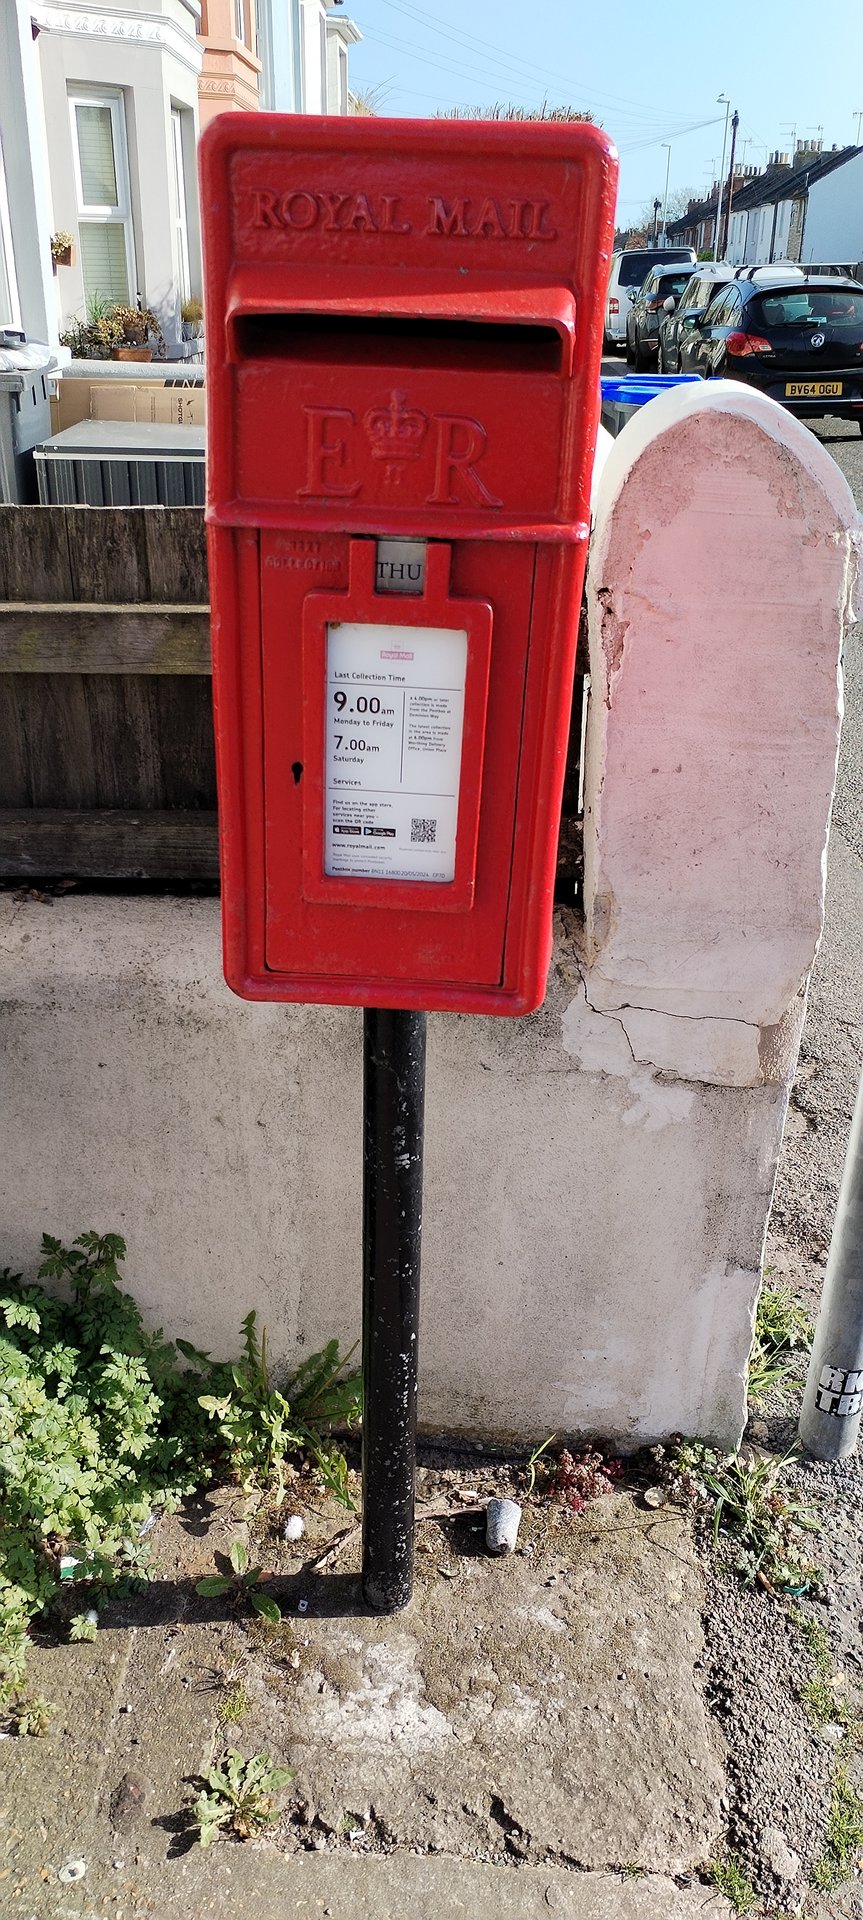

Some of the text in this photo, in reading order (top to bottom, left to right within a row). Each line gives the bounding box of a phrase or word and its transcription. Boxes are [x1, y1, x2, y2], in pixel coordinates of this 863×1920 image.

[251, 188, 558, 241] ROYAL MAIL
[790, 384, 839, 395] BV64 OGU
[297, 404, 503, 508] E R
[376, 562, 423, 581] THU
[334, 671, 406, 682] Last Collection Time
[334, 718, 360, 727] Monday
[372, 720, 394, 729] Friday
[333, 754, 364, 764] Saturday
[333, 778, 362, 786] Services
